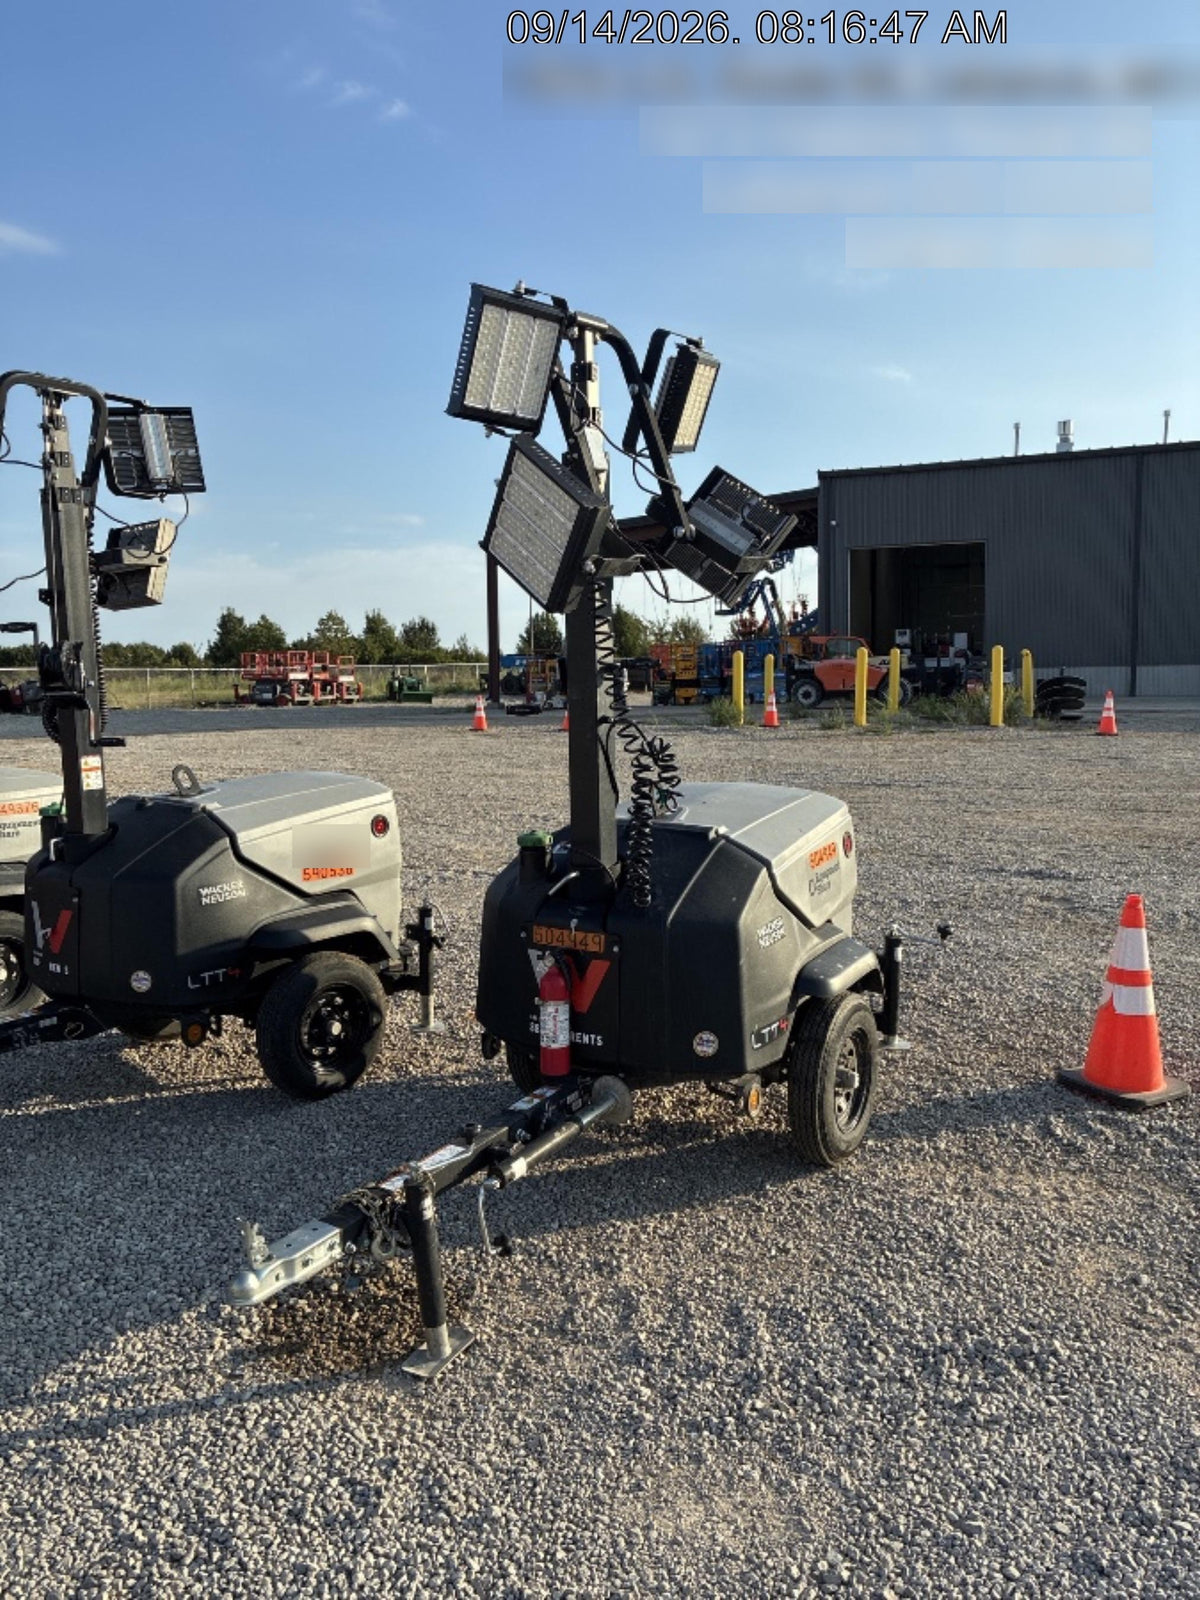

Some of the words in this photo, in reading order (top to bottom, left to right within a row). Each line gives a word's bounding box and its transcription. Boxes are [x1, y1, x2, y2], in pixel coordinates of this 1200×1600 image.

[198, 880, 244, 895] WACKER
[201, 889, 246, 906] NEUSON
[751, 1018, 790, 1050] LTT4
